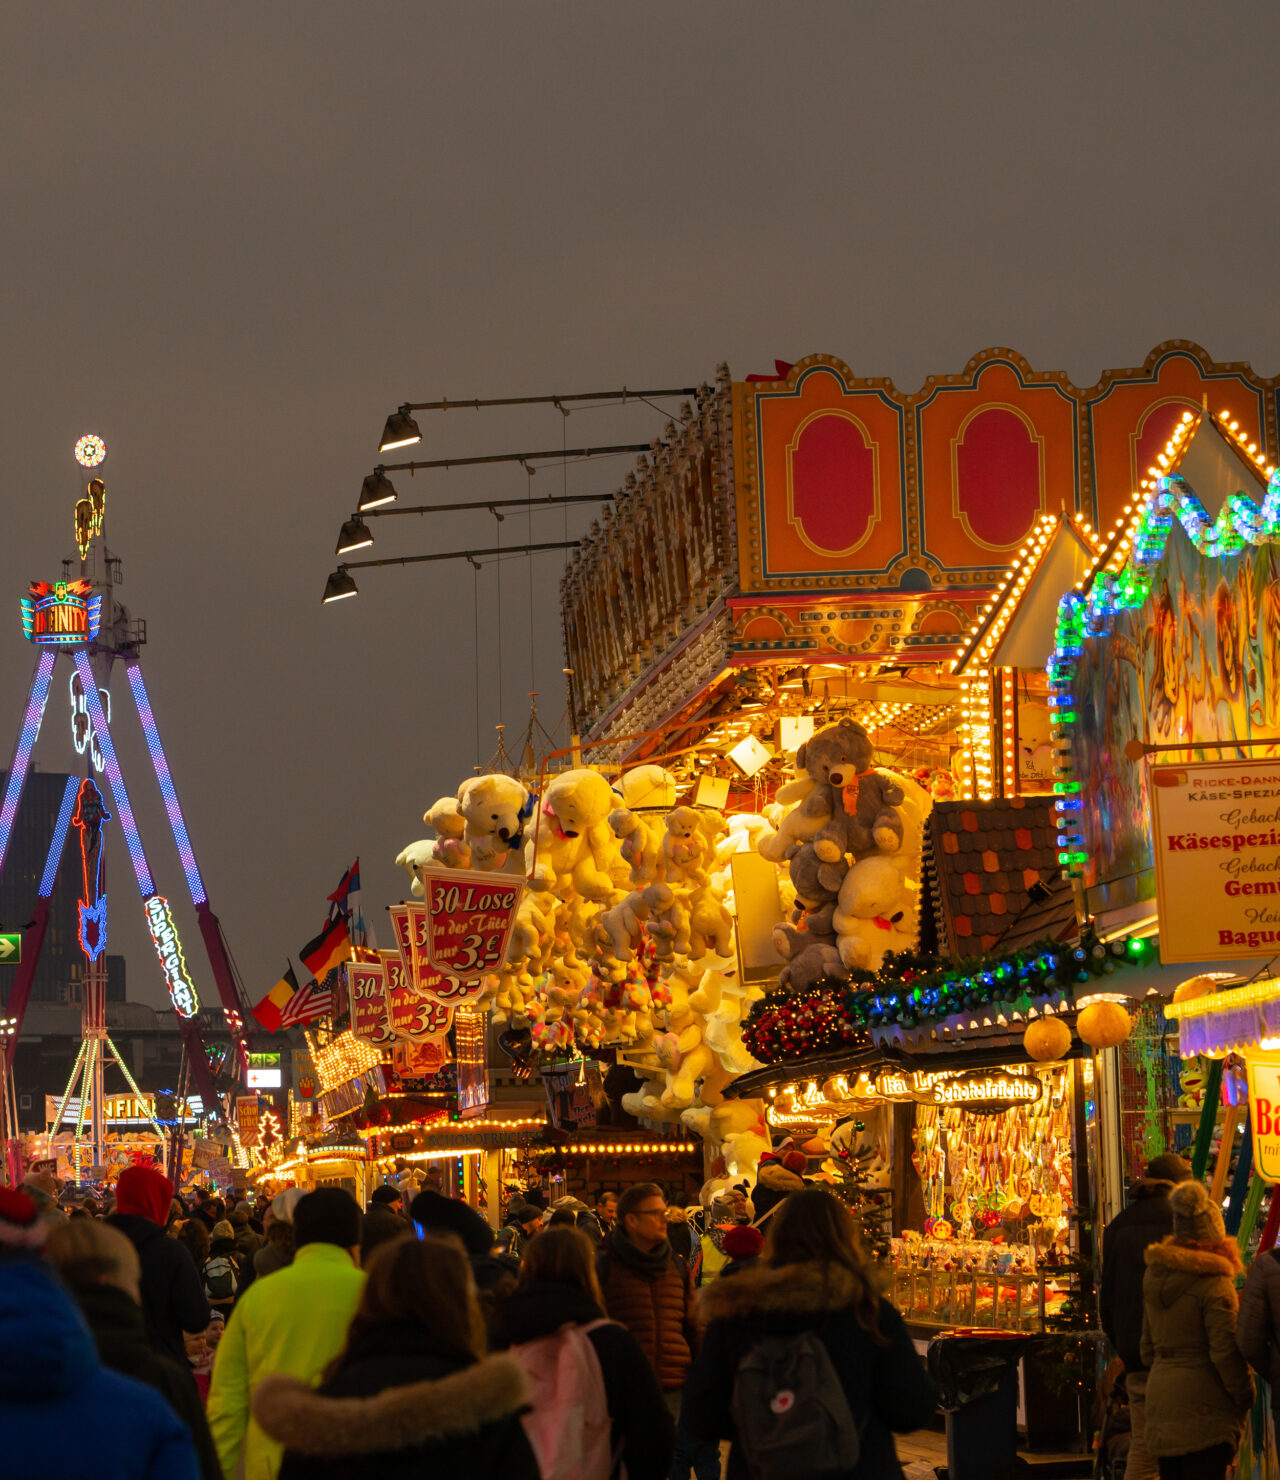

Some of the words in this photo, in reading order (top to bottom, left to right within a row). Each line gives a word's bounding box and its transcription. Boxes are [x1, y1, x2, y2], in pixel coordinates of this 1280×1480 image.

[36, 605, 87, 633] INFINITY
[1225, 880, 1280, 896] Gem
[431, 886, 461, 916] 30
[463, 888, 515, 911] Lose
[432, 926, 445, 936] in
[448, 919, 468, 934] der
[470, 914, 507, 932] Tüte
[435, 945, 458, 960] nur
[354, 976, 376, 1000] 30
[394, 1016, 414, 1027] nur
